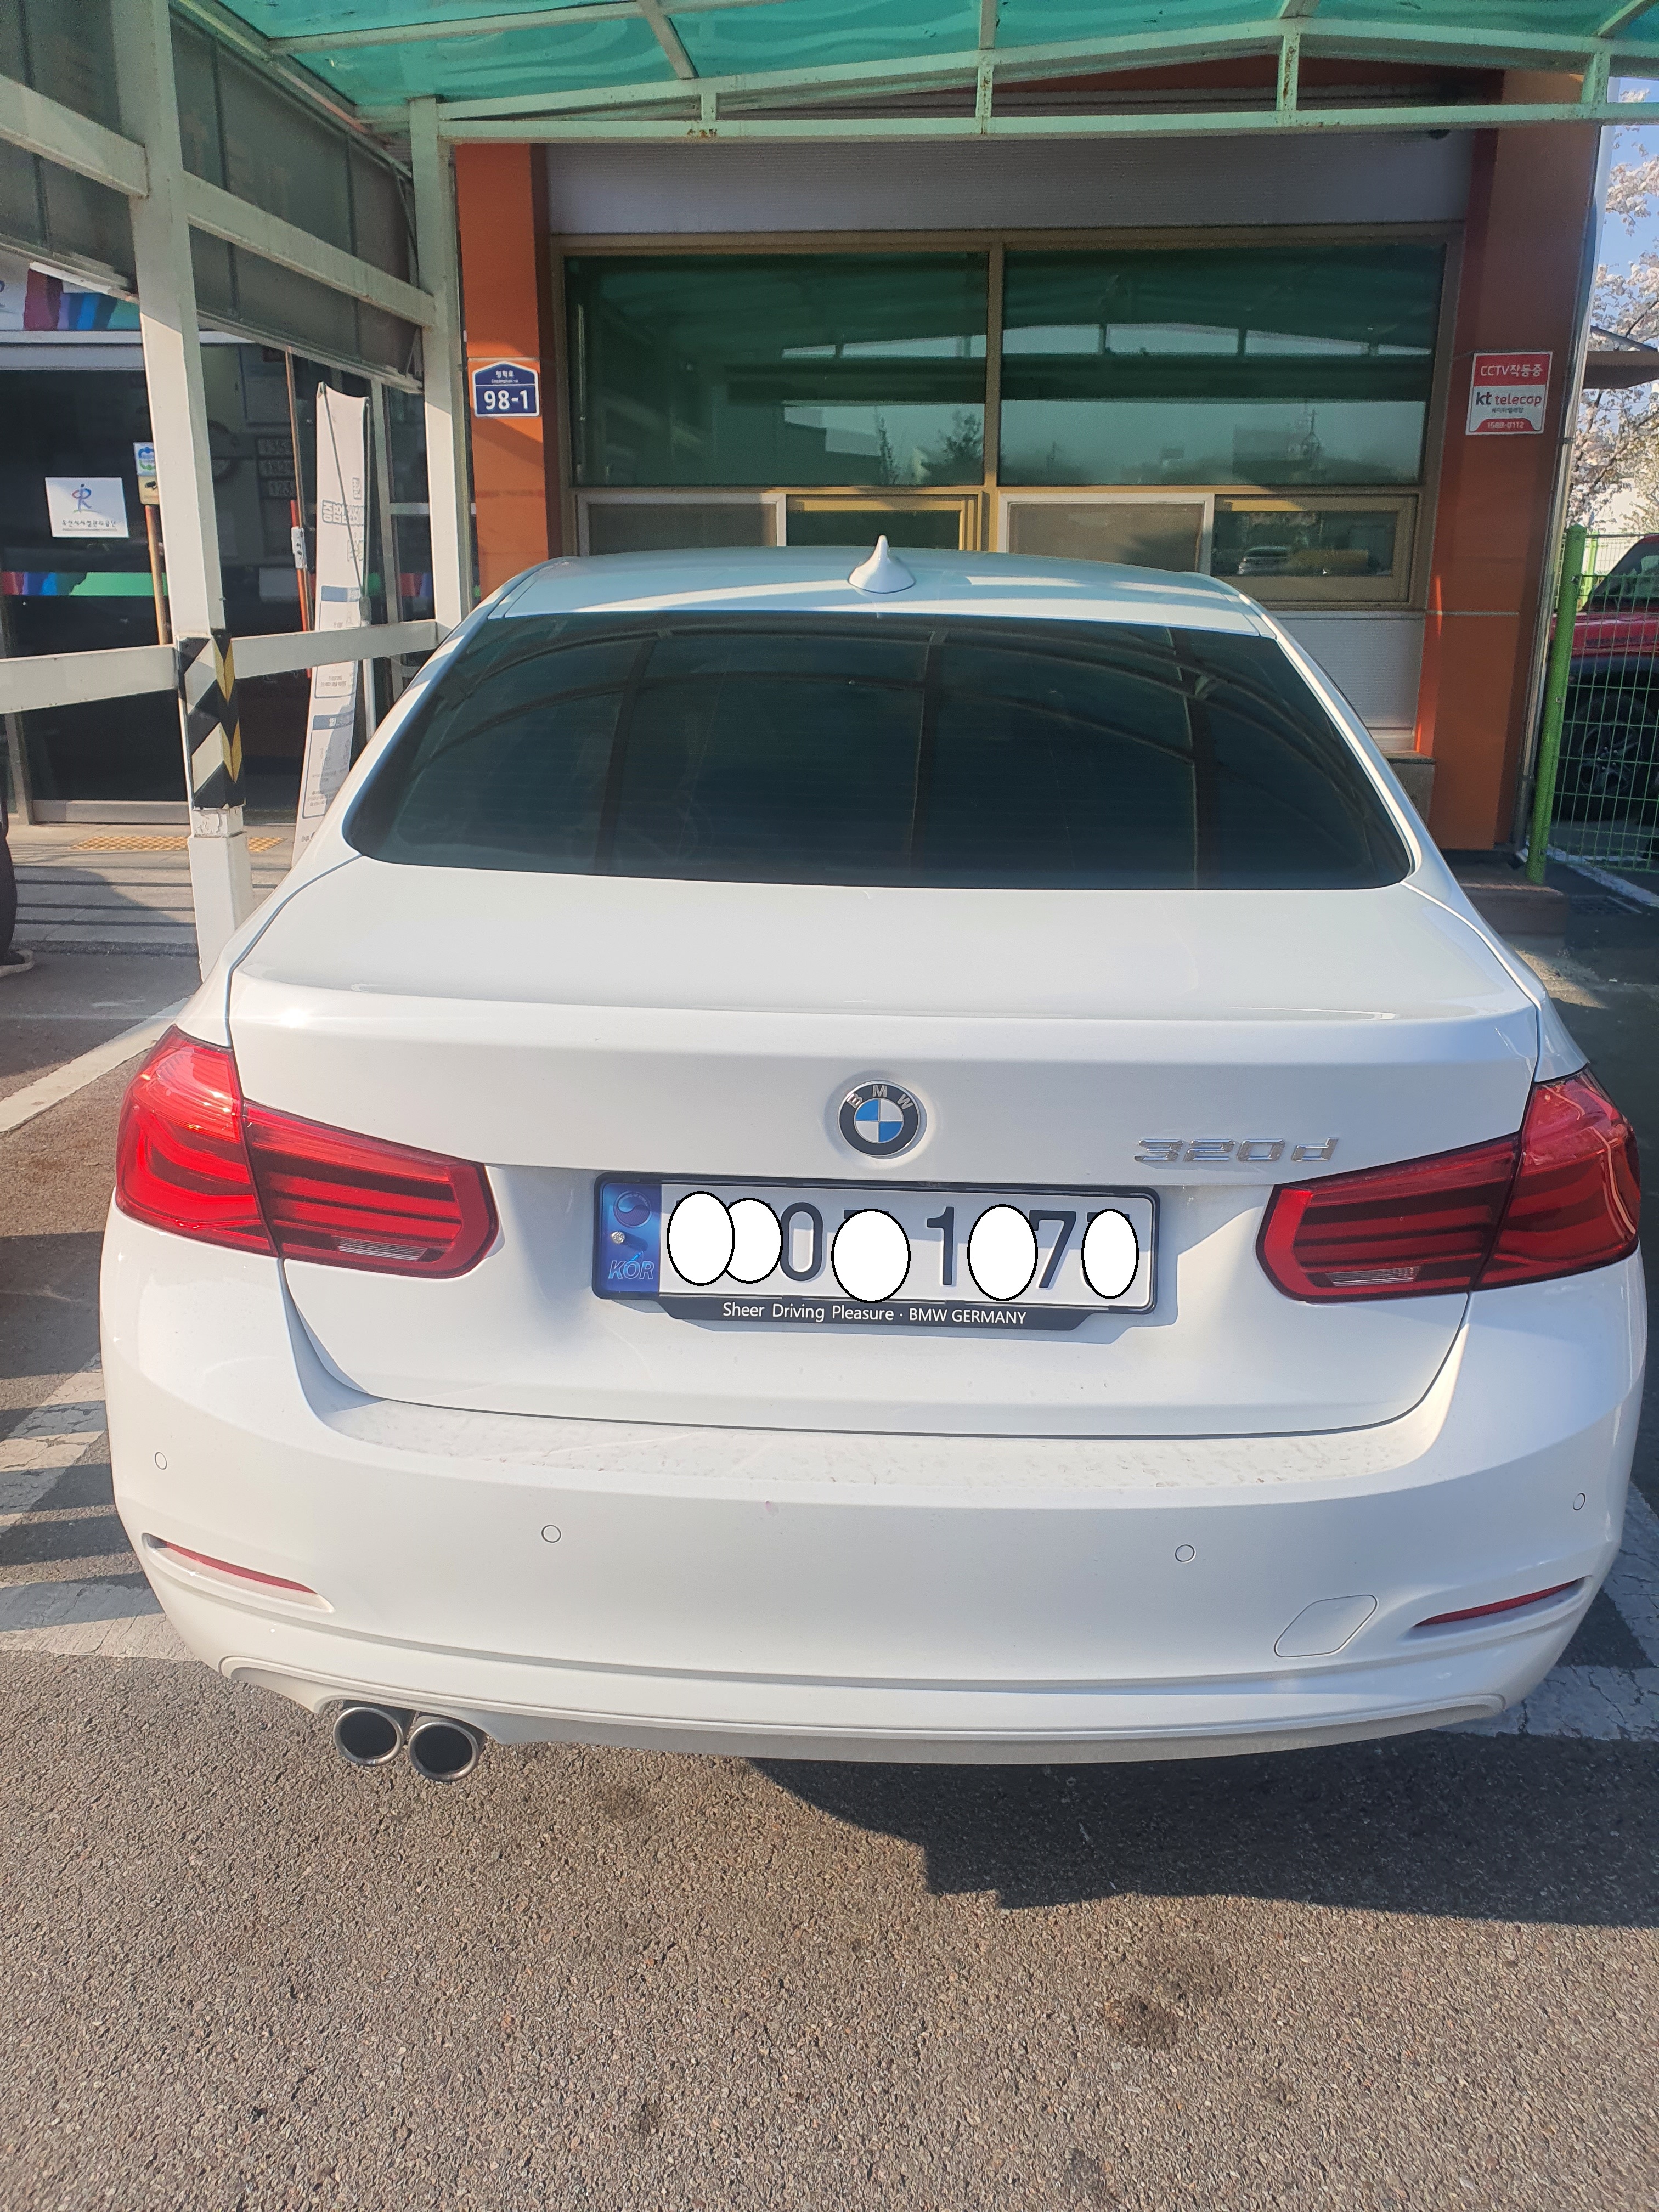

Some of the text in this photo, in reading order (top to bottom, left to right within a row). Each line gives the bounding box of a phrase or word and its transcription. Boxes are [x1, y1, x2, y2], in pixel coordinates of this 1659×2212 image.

[1480, 363, 1543, 378] CCTV작동중
[483, 390, 528, 410] 98-1
[1476, 391, 1542, 408] kt telecop
[847, 1084, 915, 1110] BMW
[1133, 1136, 1340, 1163] 320d
[608, 1260, 655, 1280] KOR
[723, 1302, 1026, 1324] Sheer Driving Pleasure BMW GERMANY
